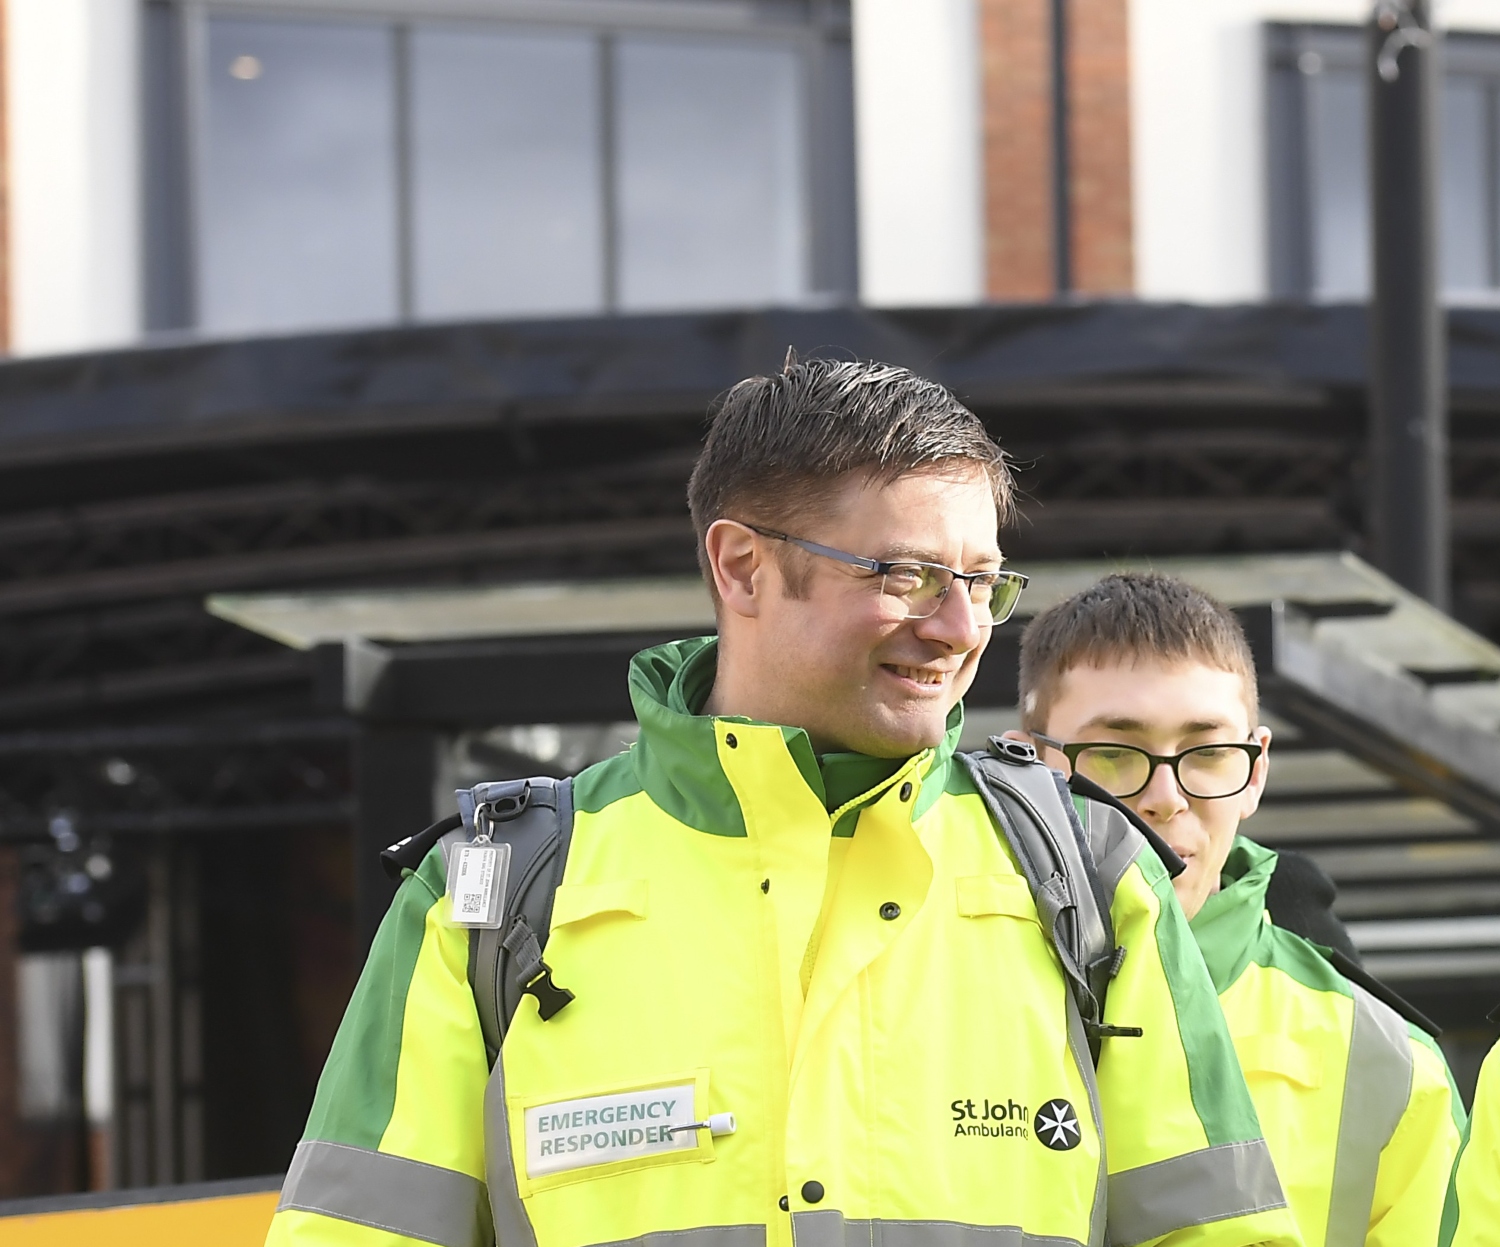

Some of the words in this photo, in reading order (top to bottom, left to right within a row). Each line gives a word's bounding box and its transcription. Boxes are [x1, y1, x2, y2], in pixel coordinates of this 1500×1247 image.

[538, 1100, 676, 1133] EMERGENCY
[951, 1098, 978, 1121] St
[540, 1124, 674, 1157] RESPONDER
[954, 1122, 1029, 1141] Ambulanc
